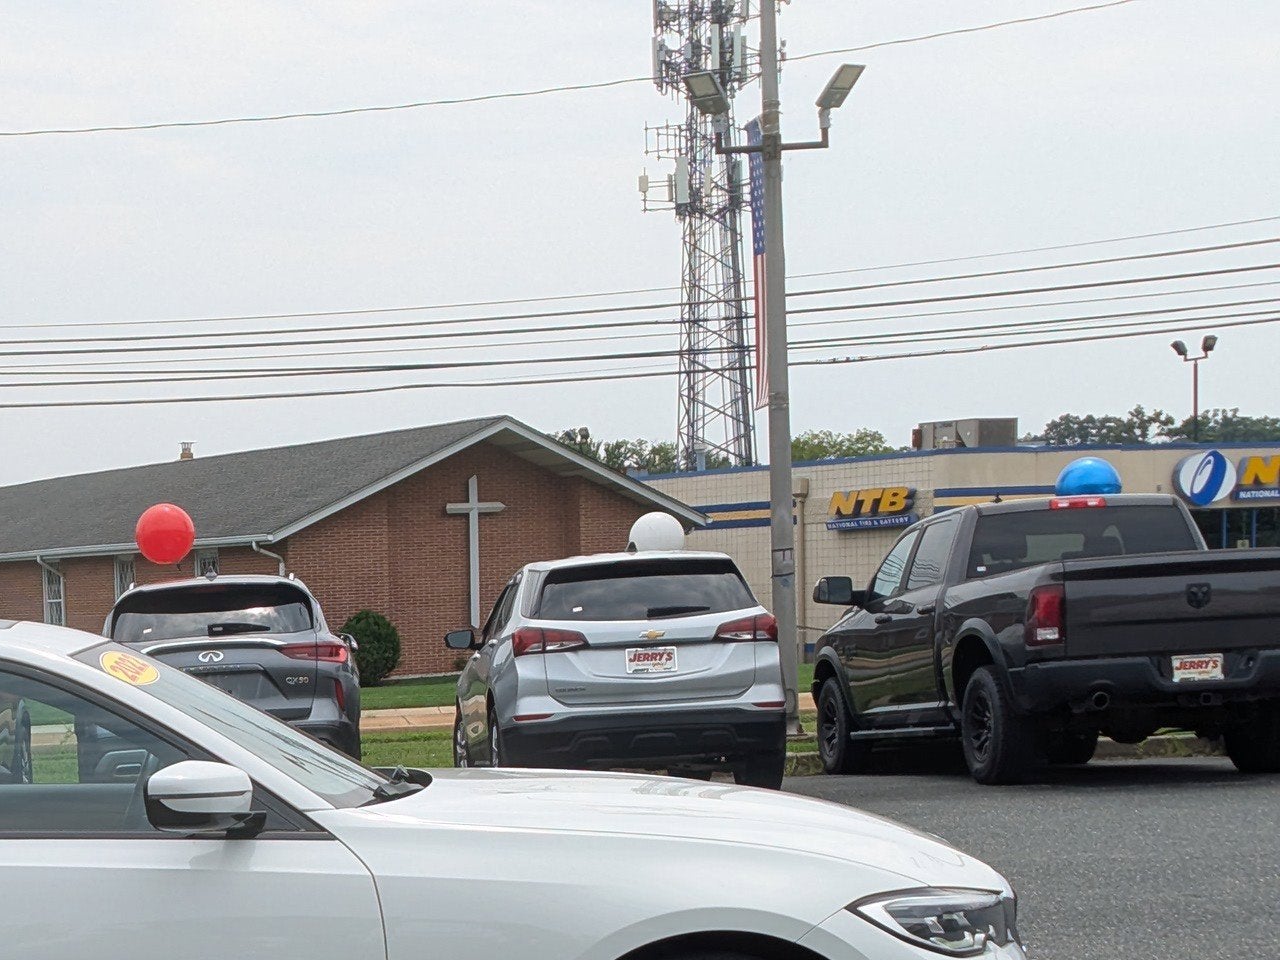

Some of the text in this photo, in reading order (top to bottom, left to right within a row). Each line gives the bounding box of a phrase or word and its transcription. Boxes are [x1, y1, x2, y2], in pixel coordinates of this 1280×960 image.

[1239, 489, 1280, 499] NATIONAL
[828, 487, 908, 515] NTB
[880, 516, 909, 525] BATTERY
[629, 652, 673, 662] JERRY'S
[1175, 660, 1219, 670] JERRY'S
